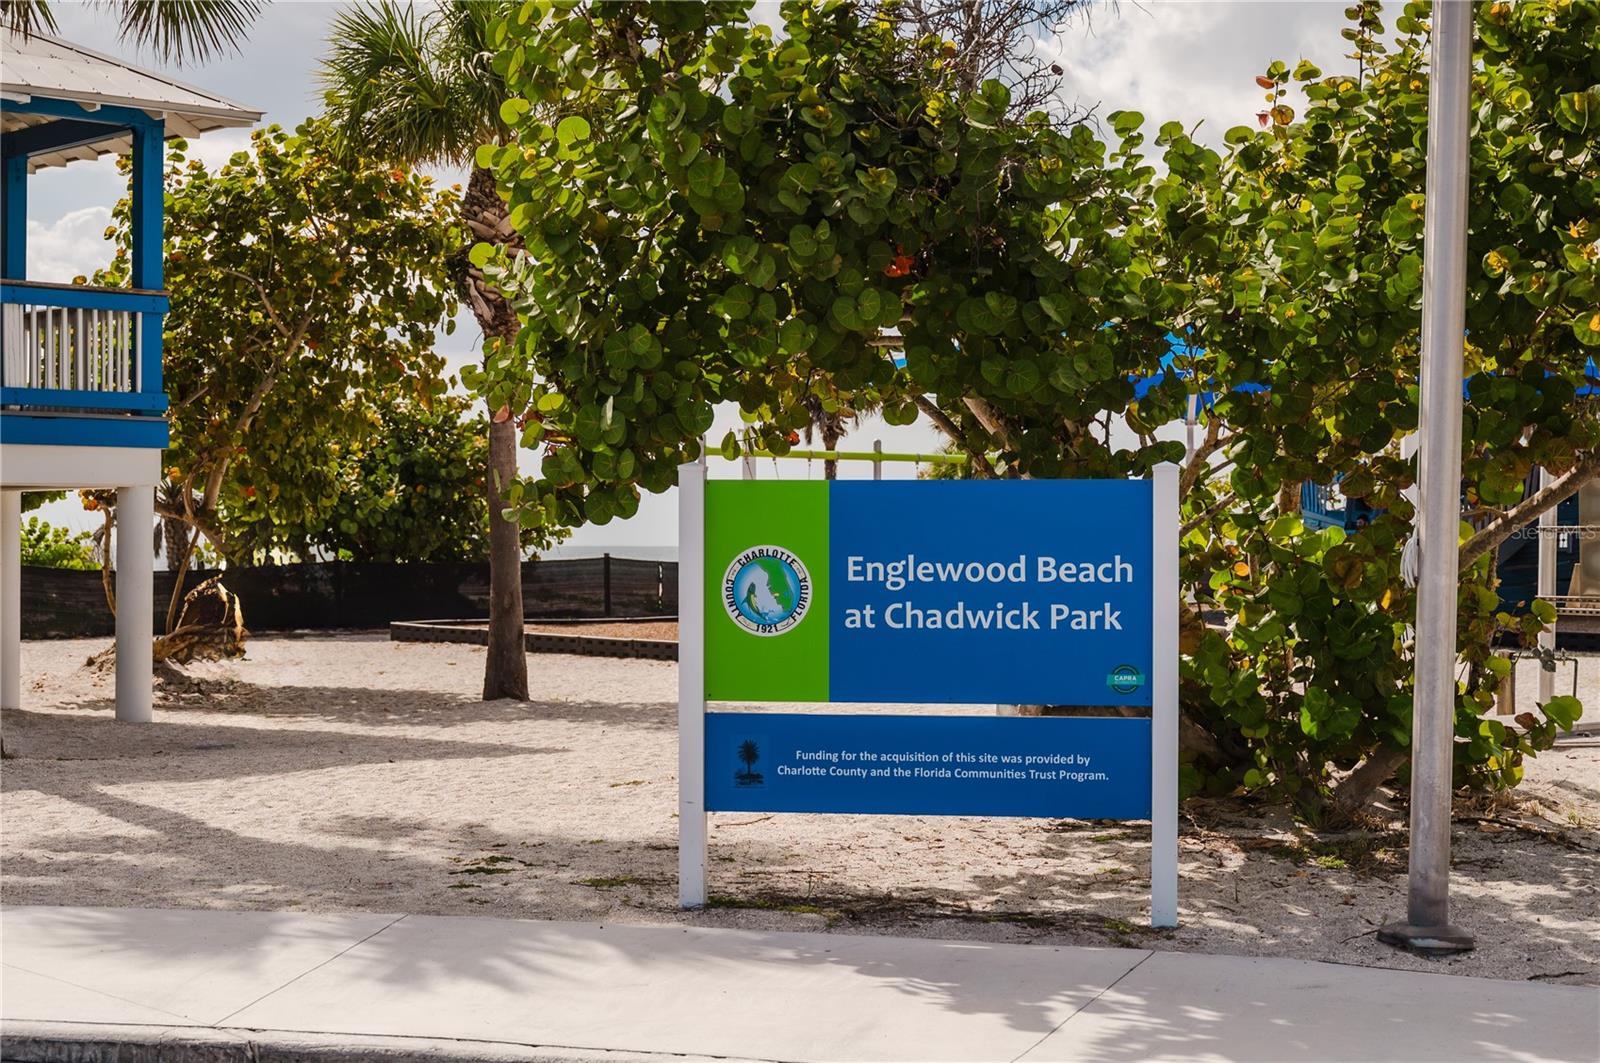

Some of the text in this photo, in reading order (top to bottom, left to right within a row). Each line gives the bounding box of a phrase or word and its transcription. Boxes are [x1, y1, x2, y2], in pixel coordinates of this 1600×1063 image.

[737, 548, 797, 567] CHARLOTTE
[847, 554, 1133, 591] Englewood Beach
[725, 579, 741, 619] COUNTY
[791, 577, 809, 621] FLORIDA
[844, 601, 1123, 630] at Chadwick Park
[756, 624, 778, 634] 1921
[796, 750, 1091, 767] Funding for the acquisition of this site was provided by
[777, 765, 1109, 782] Charlotte County and the Florida Communities Trust Program.
